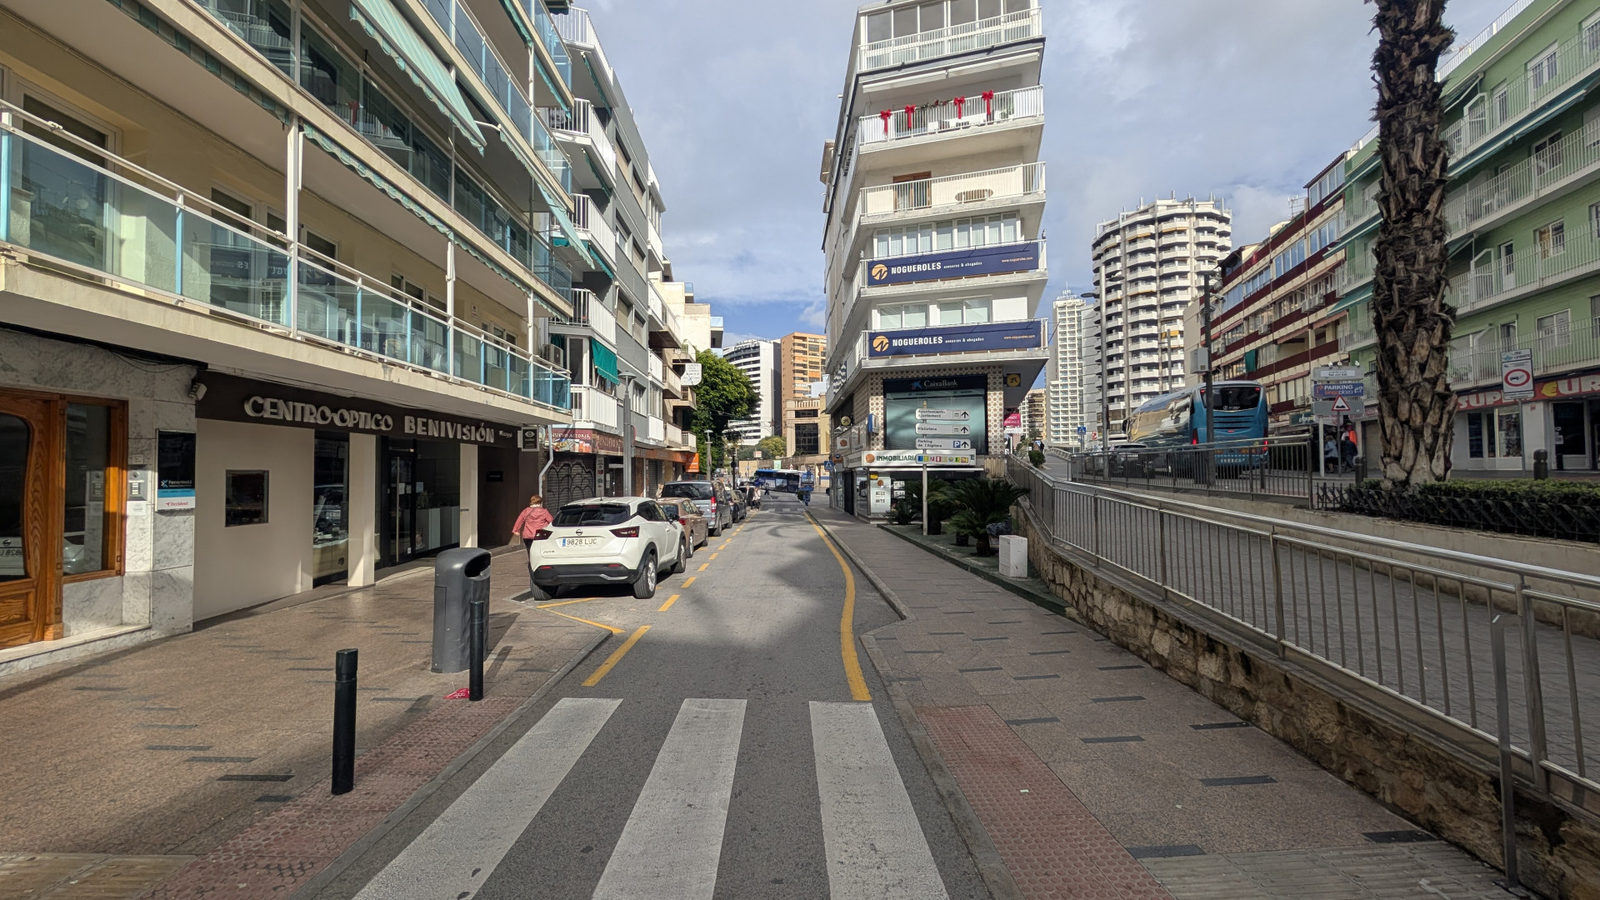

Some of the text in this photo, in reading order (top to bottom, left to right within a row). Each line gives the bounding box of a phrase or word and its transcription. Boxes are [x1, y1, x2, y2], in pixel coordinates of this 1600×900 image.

[891, 262, 942, 275] NOGUEROLES
[892, 336, 943, 347] NOGUEROLES
[923, 379, 958, 387] CaixaBank
[404, 415, 495, 443] BENIVISIÓN
[566, 538, 583, 546] 9828
